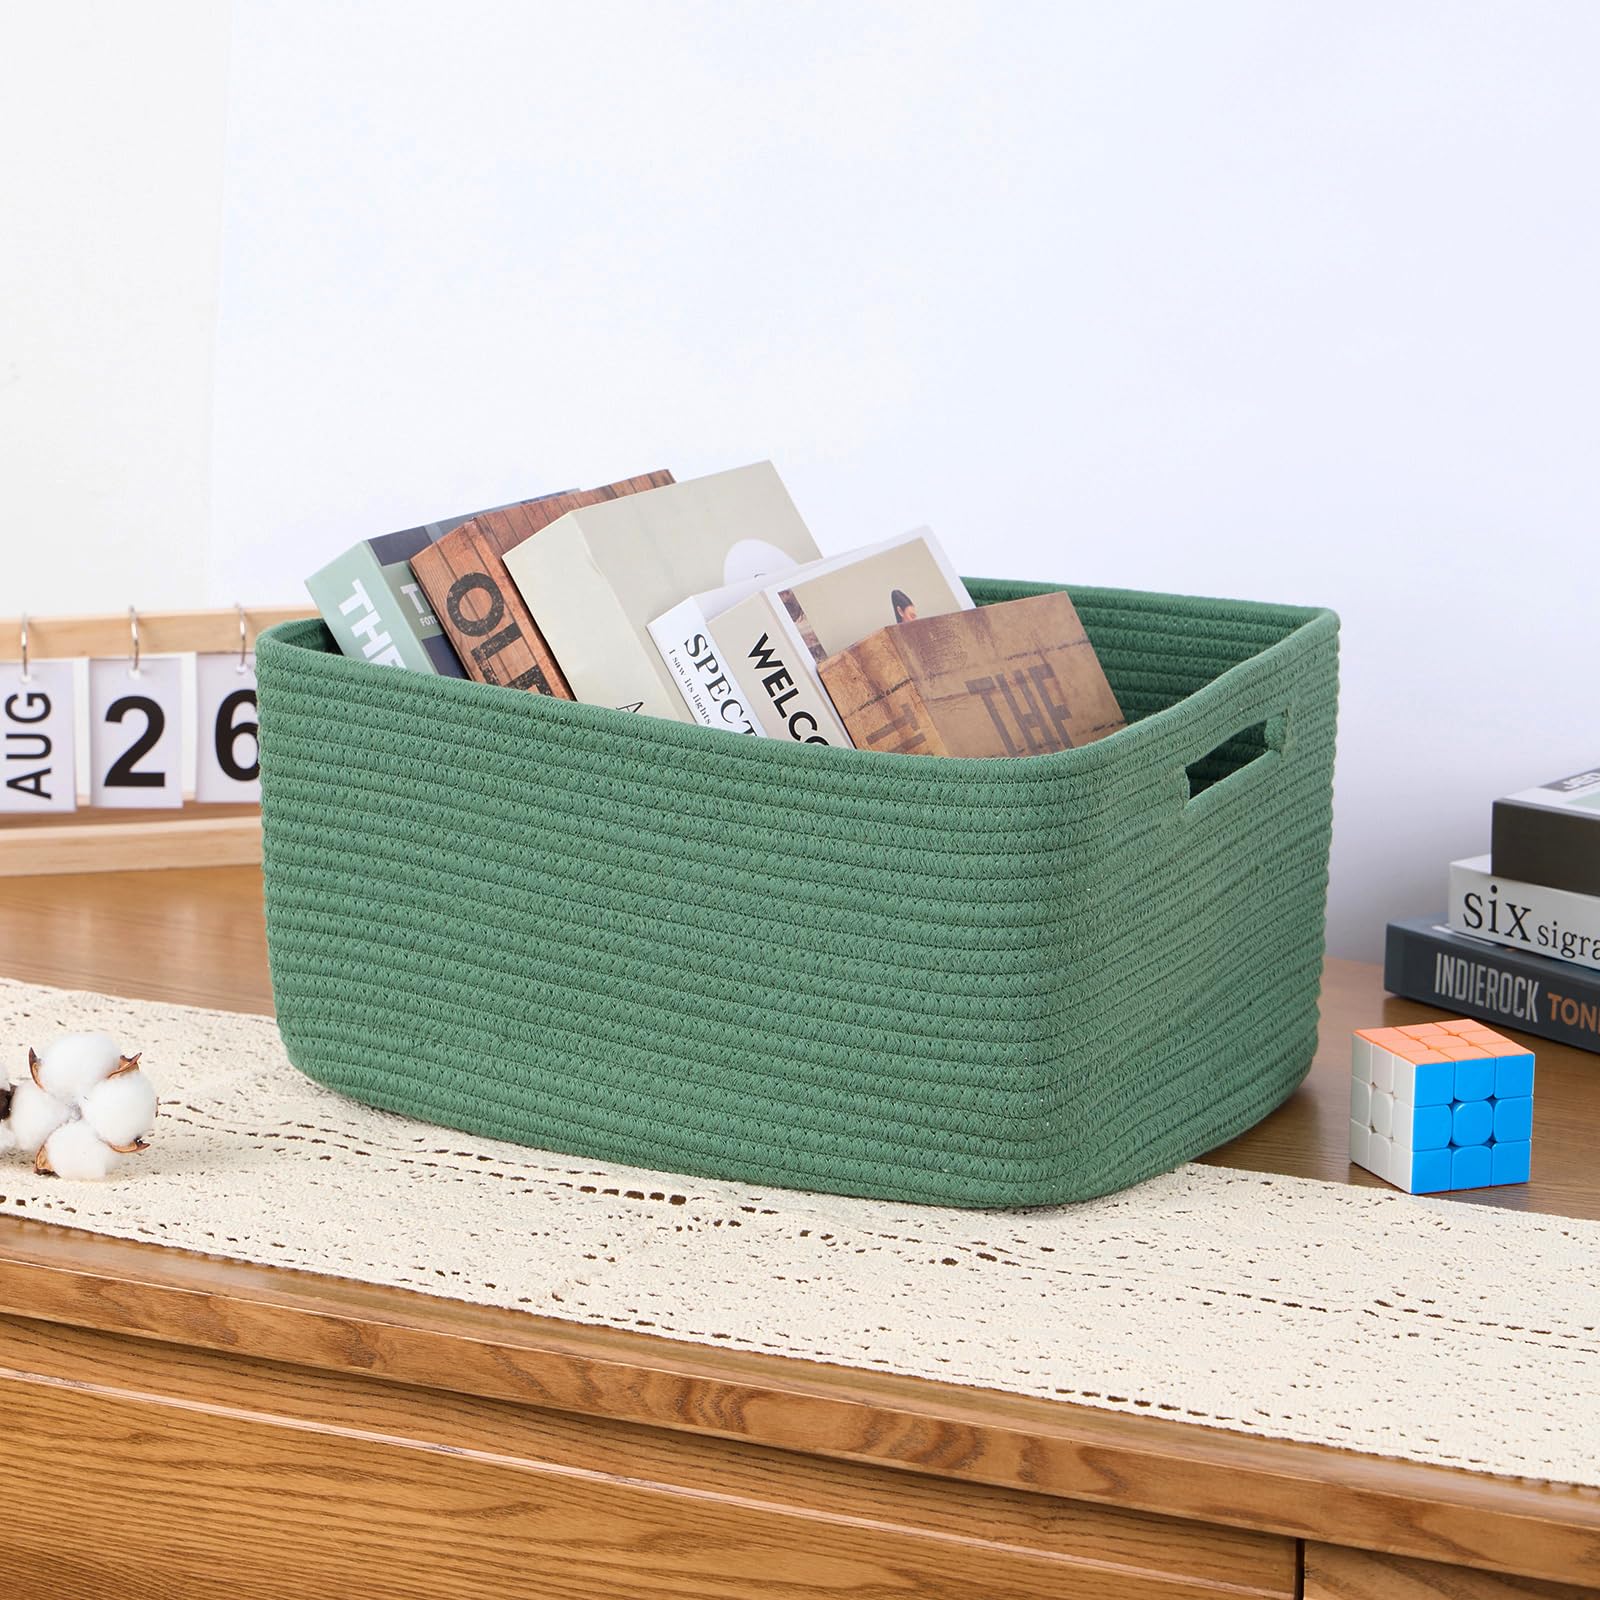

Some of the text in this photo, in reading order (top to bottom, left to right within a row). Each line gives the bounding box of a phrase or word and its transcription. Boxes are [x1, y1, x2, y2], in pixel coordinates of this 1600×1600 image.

[672, 657, 687, 677] saw
[684, 678, 694, 693] its
[692, 694, 712, 725] lights
[5, 692, 52, 800] AUG
[103, 695, 166, 788] 2
[1463, 884, 1532, 942] six
[1434, 952, 1540, 1023] INDIEROCK
